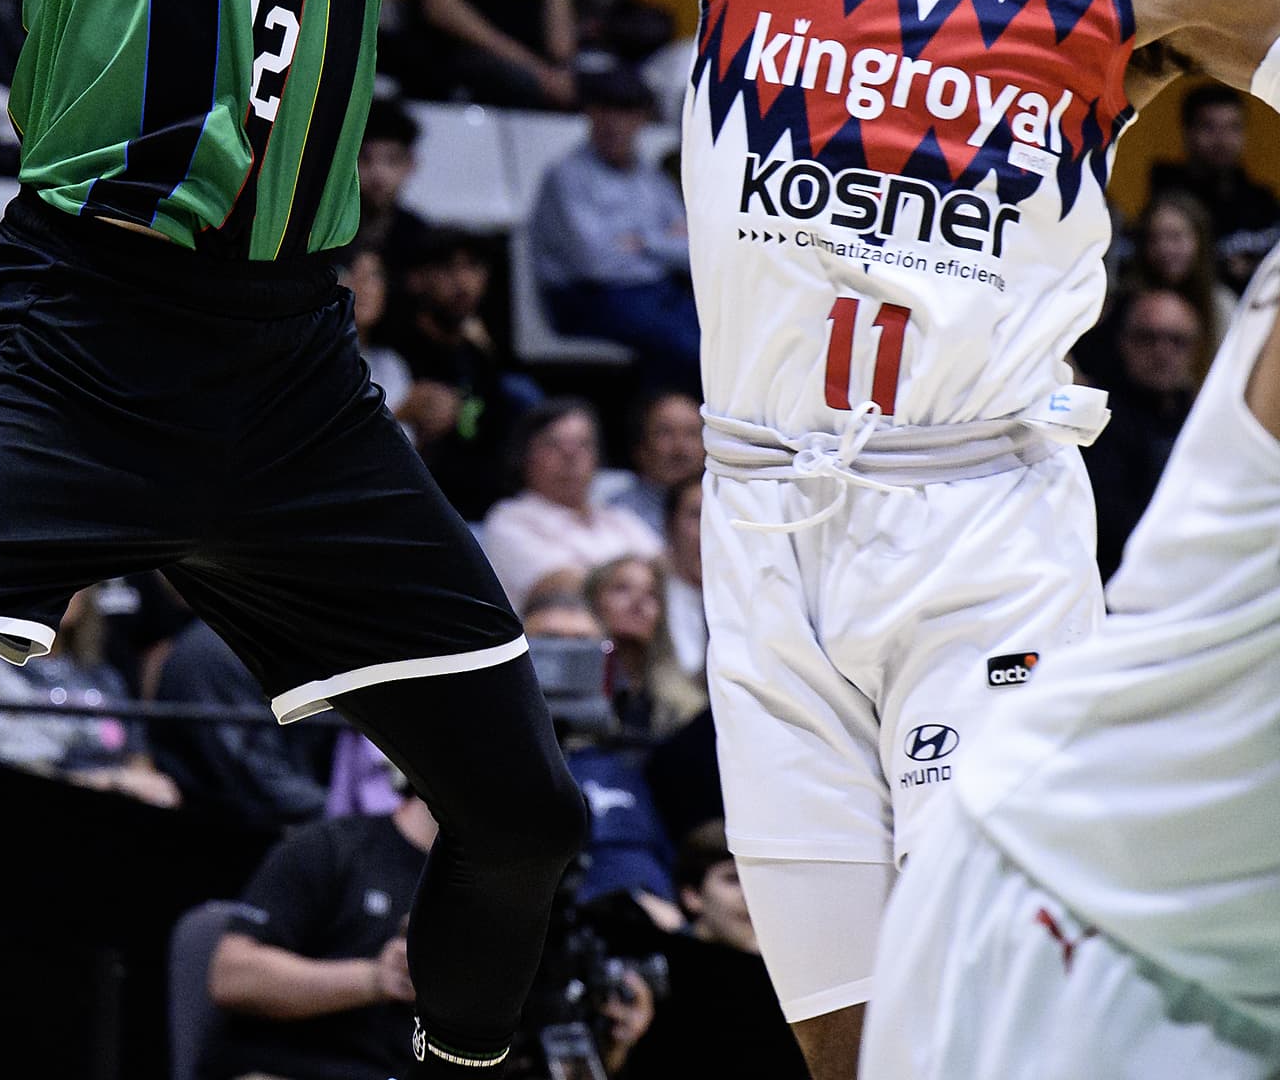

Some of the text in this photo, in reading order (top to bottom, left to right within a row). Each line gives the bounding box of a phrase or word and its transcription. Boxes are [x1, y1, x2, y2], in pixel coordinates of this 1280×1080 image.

[743, 11, 1073, 154] kingroyal
[824, 296, 912, 417] 11
[990, 664, 1031, 685] acb
